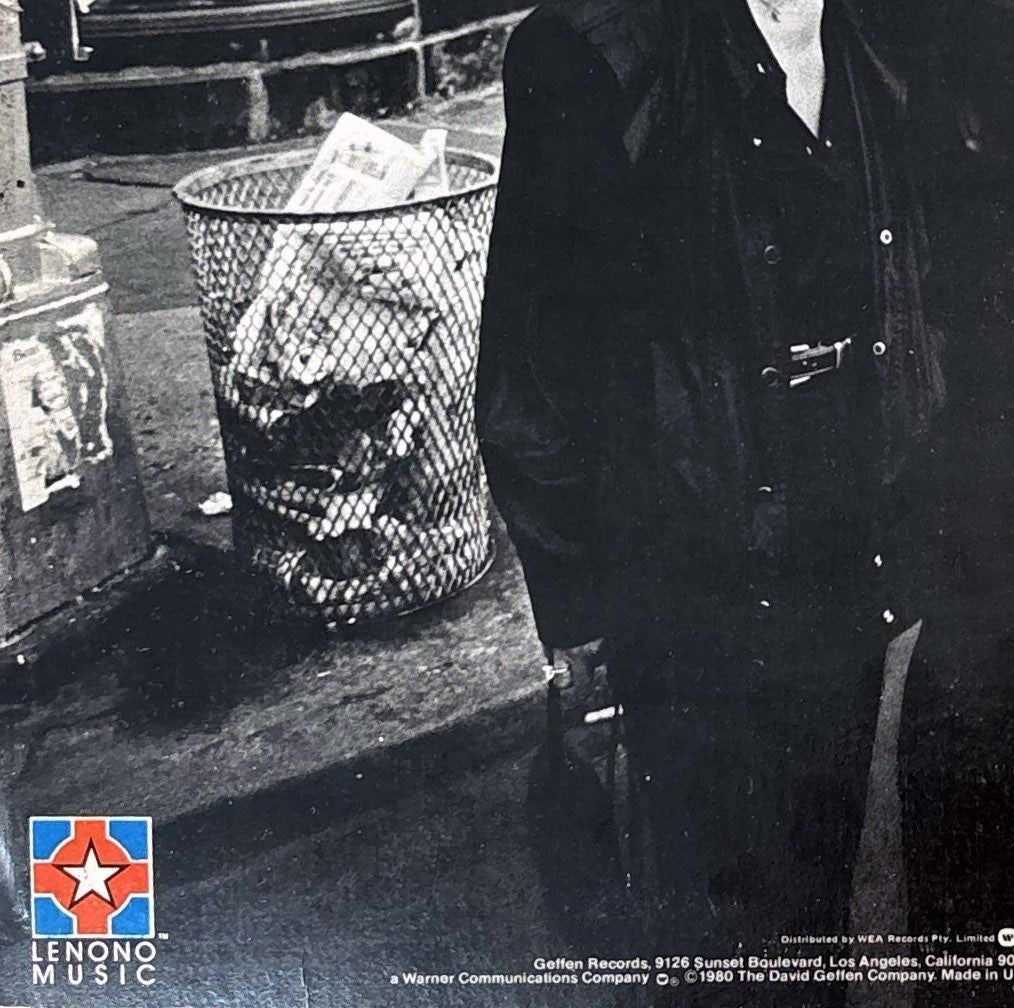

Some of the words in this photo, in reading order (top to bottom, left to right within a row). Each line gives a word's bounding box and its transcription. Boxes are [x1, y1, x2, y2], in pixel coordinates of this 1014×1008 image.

[781, 935, 839, 944] Distributed
[842, 935, 855, 945] by
[858, 935, 884, 944] WEA
[888, 935, 929, 944] Records
[932, 935, 953, 945] Pty.
[956, 935, 995, 944] Limited
[32, 941, 156, 962] LENONO
[534, 957, 583, 969] Geffen
[588, 957, 652, 970] Records,
[655, 956, 689, 969] 9126
[694, 956, 744, 969] Sunset
[749, 956, 826, 969] Boulevard,
[830, 955, 855, 968] Los
[859, 955, 921, 970] Angeles,
[925, 954, 993, 967] California
[32, 964, 156, 985] MUSIC
[390, 975, 398, 984] a
[402, 973, 454, 984] Warner
[458, 972, 578, 984] Communications
[582, 972, 649, 987] Company
[738, 970, 765, 983] The
[769, 970, 810, 982] David
[813, 969, 863, 982] Geffen
[867, 969, 938, 985] Company.
[941, 968, 981, 982] Made
[985, 968, 998, 981] in
